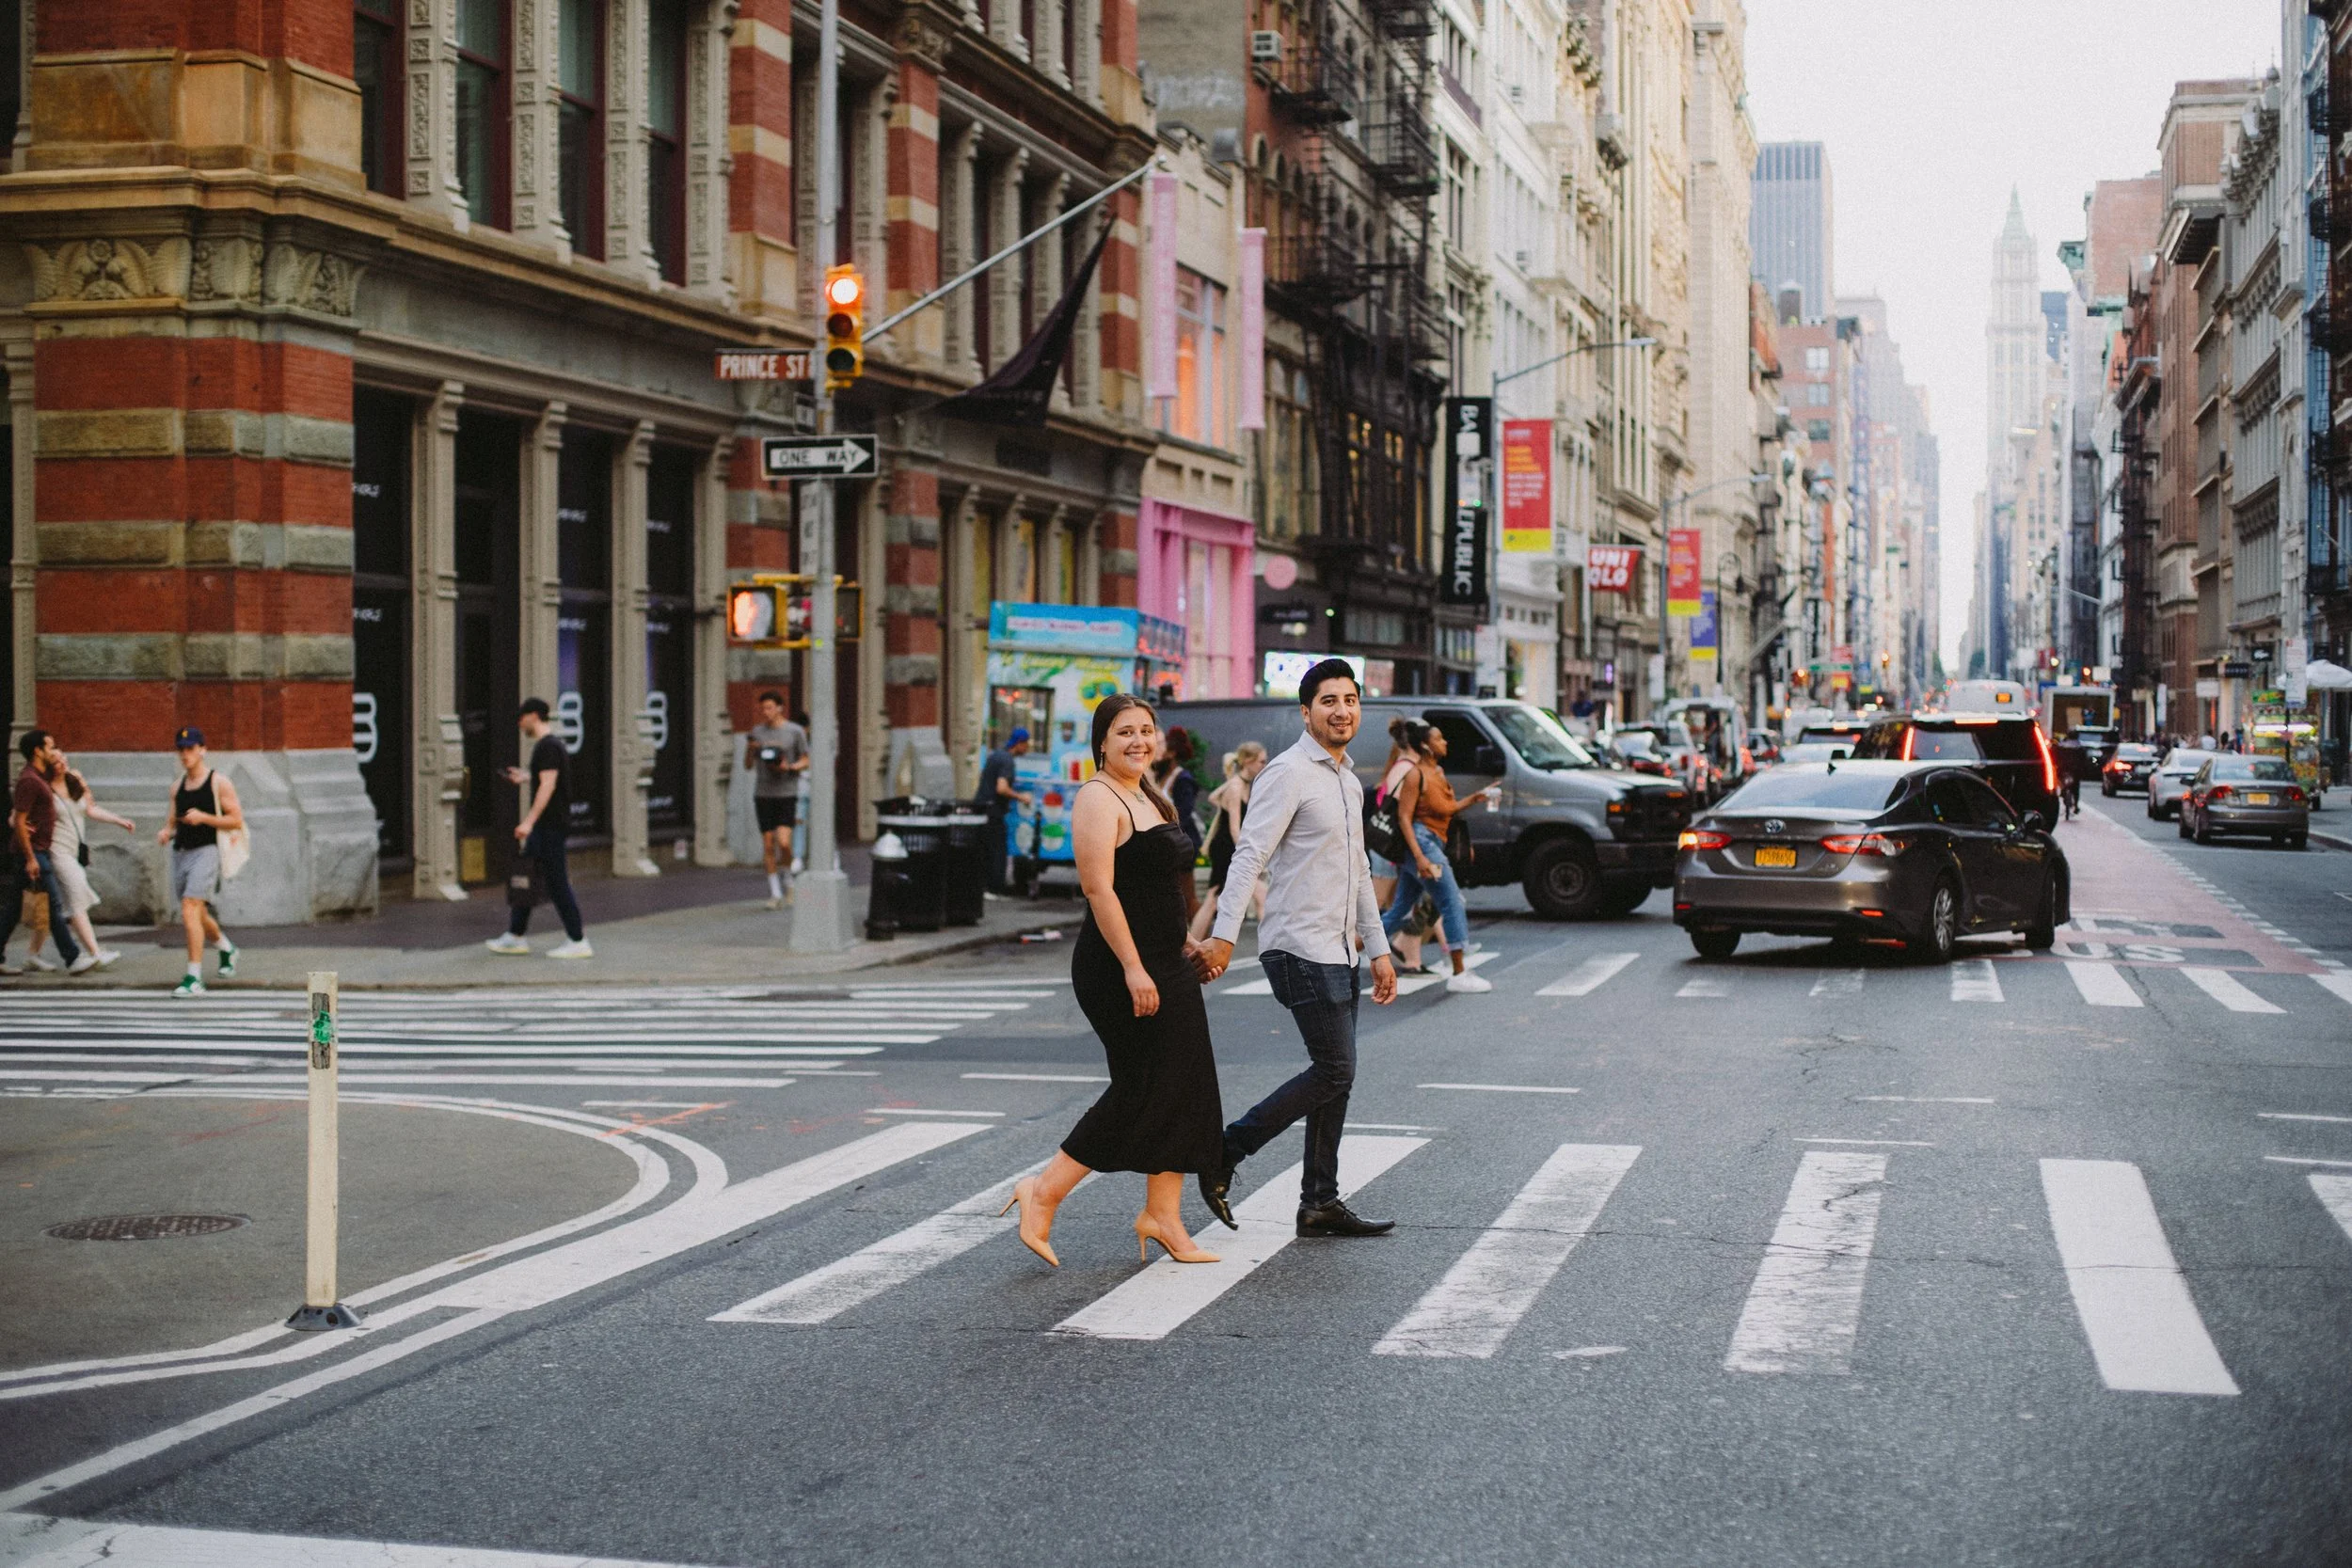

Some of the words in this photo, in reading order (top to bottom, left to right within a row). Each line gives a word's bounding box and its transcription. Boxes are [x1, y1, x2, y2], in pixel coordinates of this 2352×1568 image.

[720, 354, 778, 378] PRINCE
[786, 354, 806, 378] ST
[779, 451, 812, 465] ONE
[826, 450, 858, 463] WAY
[1454, 508, 1475, 596] EPUBLIC
[1591, 549, 1629, 567] UNI
[2011, 942, 2185, 963] US
